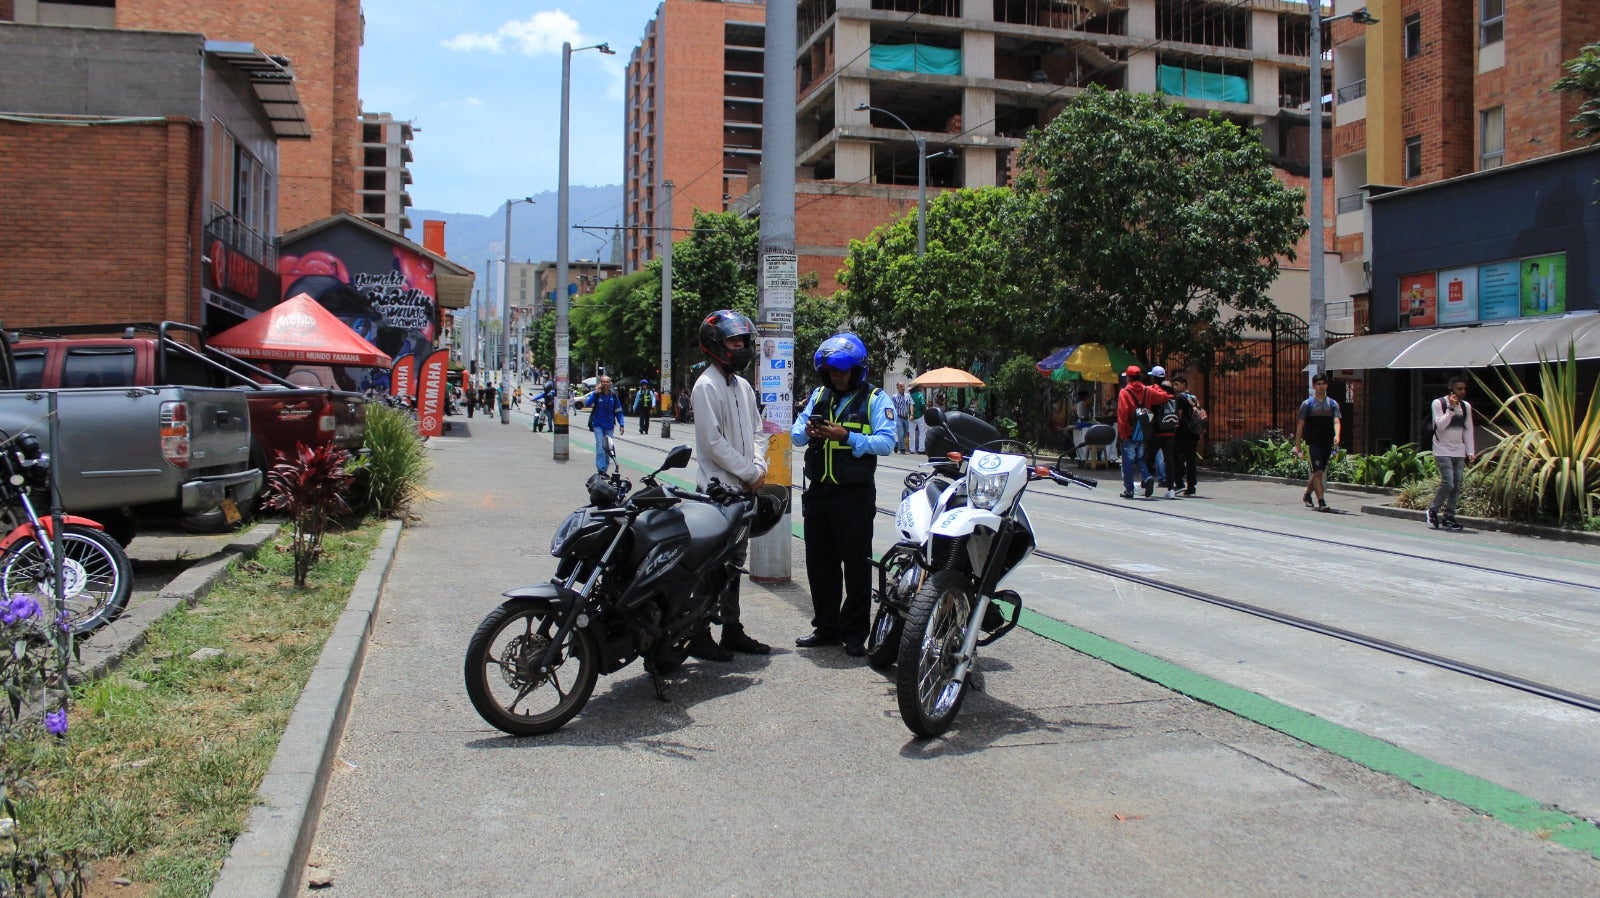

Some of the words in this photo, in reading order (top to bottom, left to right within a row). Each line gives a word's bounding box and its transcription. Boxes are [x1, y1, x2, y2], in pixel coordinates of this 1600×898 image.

[306, 351, 331, 360] MUNDO
[332, 353, 360, 362] YAMAHA
[397, 365, 409, 397] MAHA
[423, 362, 442, 415] YAMAHA
[780, 393, 790, 402] 10
